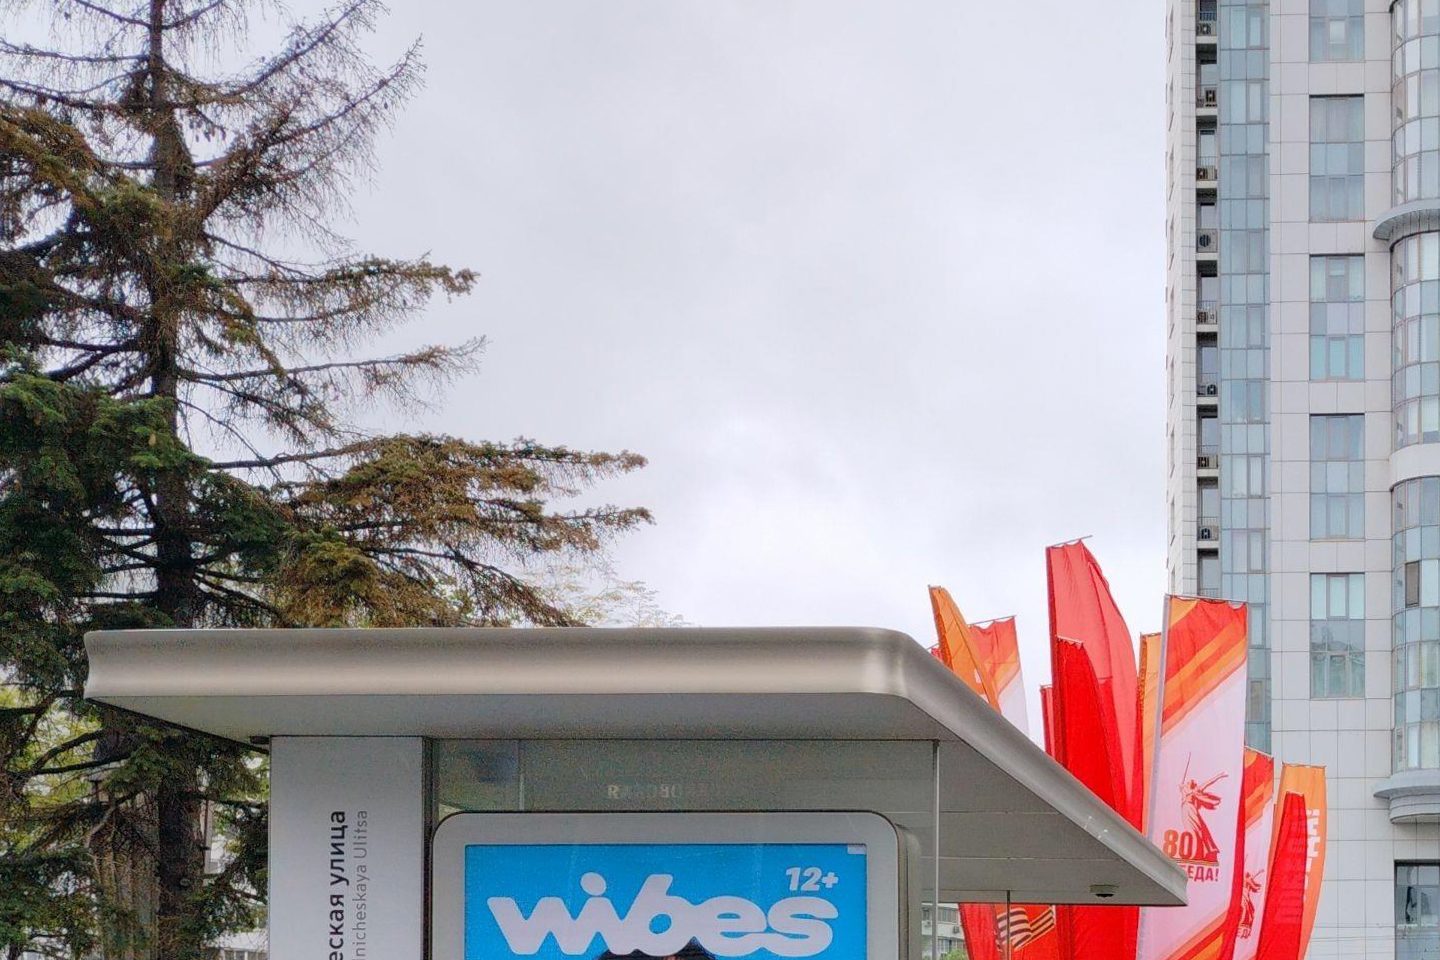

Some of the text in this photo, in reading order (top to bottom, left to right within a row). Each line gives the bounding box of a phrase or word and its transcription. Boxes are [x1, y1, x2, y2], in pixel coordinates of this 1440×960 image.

[330, 811, 349, 886] улица
[353, 810, 368, 859] Ulitsa
[1163, 829, 1193, 860] 80
[785, 867, 839, 891] 12+
[487, 872, 839, 957] wibes
